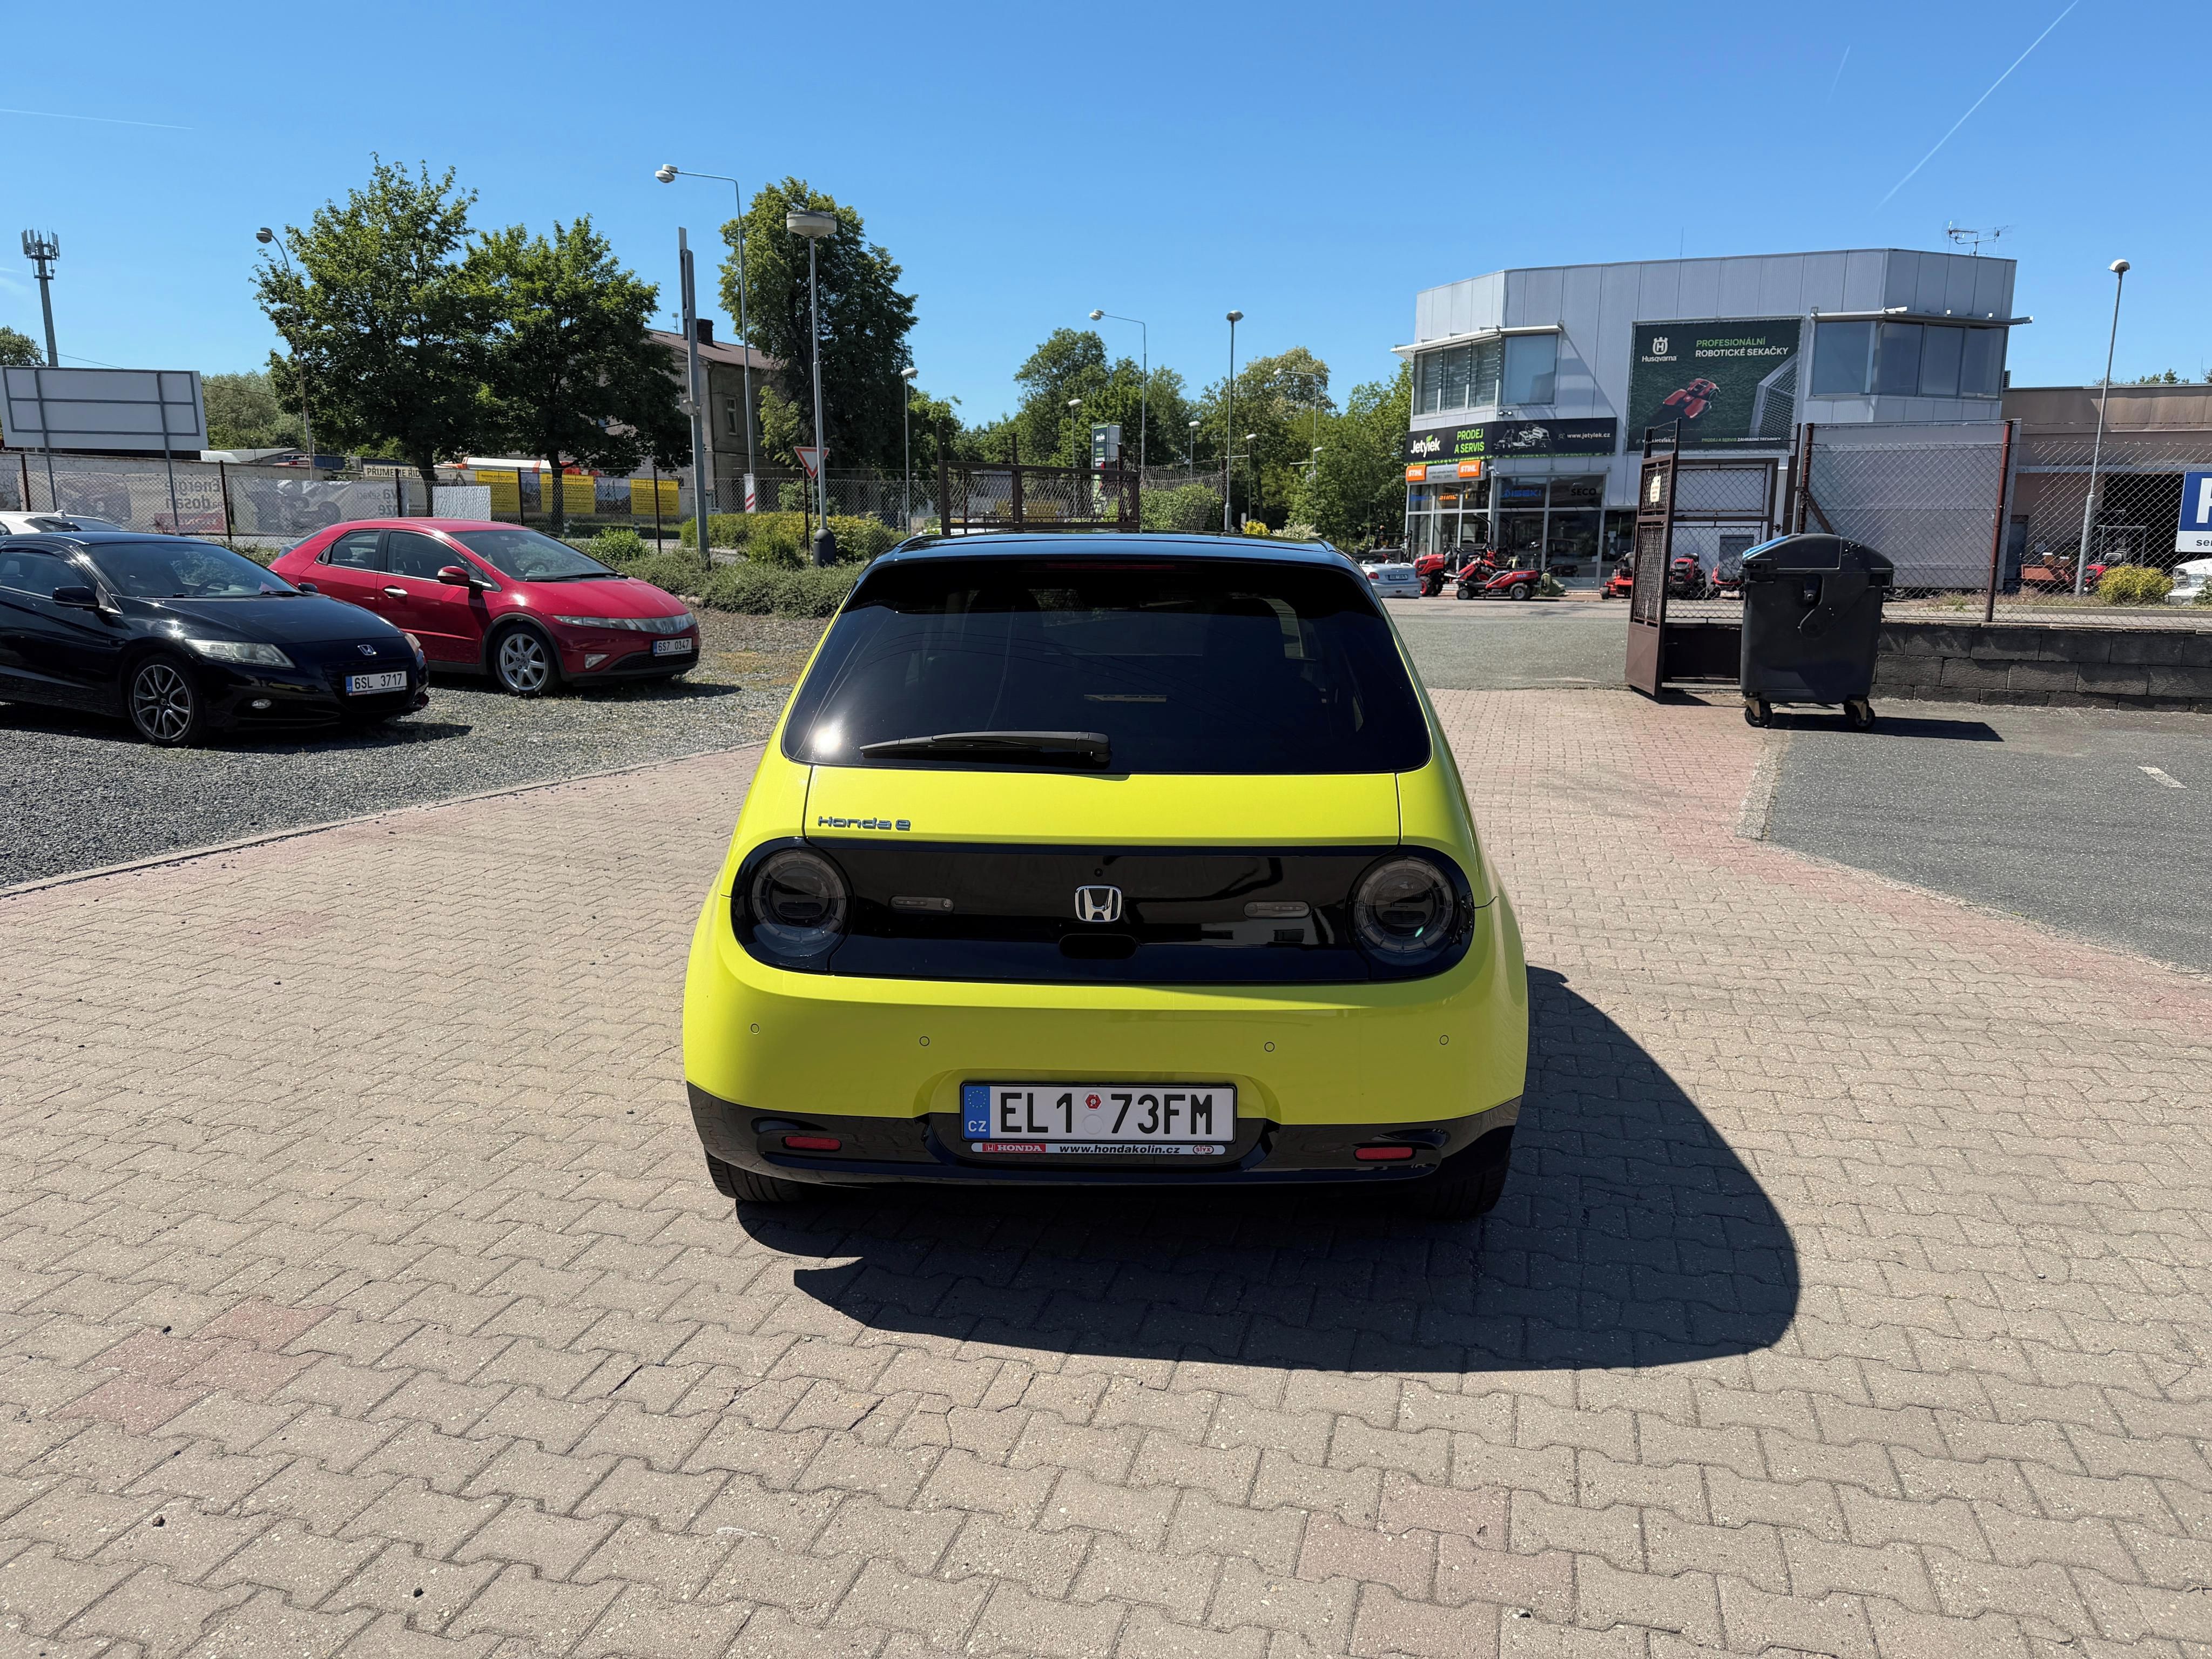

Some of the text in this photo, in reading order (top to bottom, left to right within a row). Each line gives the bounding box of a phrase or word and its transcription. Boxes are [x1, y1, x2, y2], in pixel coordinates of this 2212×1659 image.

[1696, 336, 1766, 347] PROFESIONÁLNÍ
[1695, 346, 1789, 357] ROBOTICKÉ SEKAČKY
[1457, 428, 1483, 441] PRODEJ
[1454, 442, 1485, 454] A SERVIS
[1460, 464, 1477, 473] STIHL
[1571, 488, 1596, 496] SECO
[658, 639, 689, 651] 6S7 0347
[355, 673, 402, 689] 6SL 3717
[818, 815, 911, 831] Honda e
[1001, 1092, 1212, 1135] EL1 73FM
[968, 1121, 987, 1132] CZ
[1060, 1144, 1181, 1154] www.hondakolin.cz
